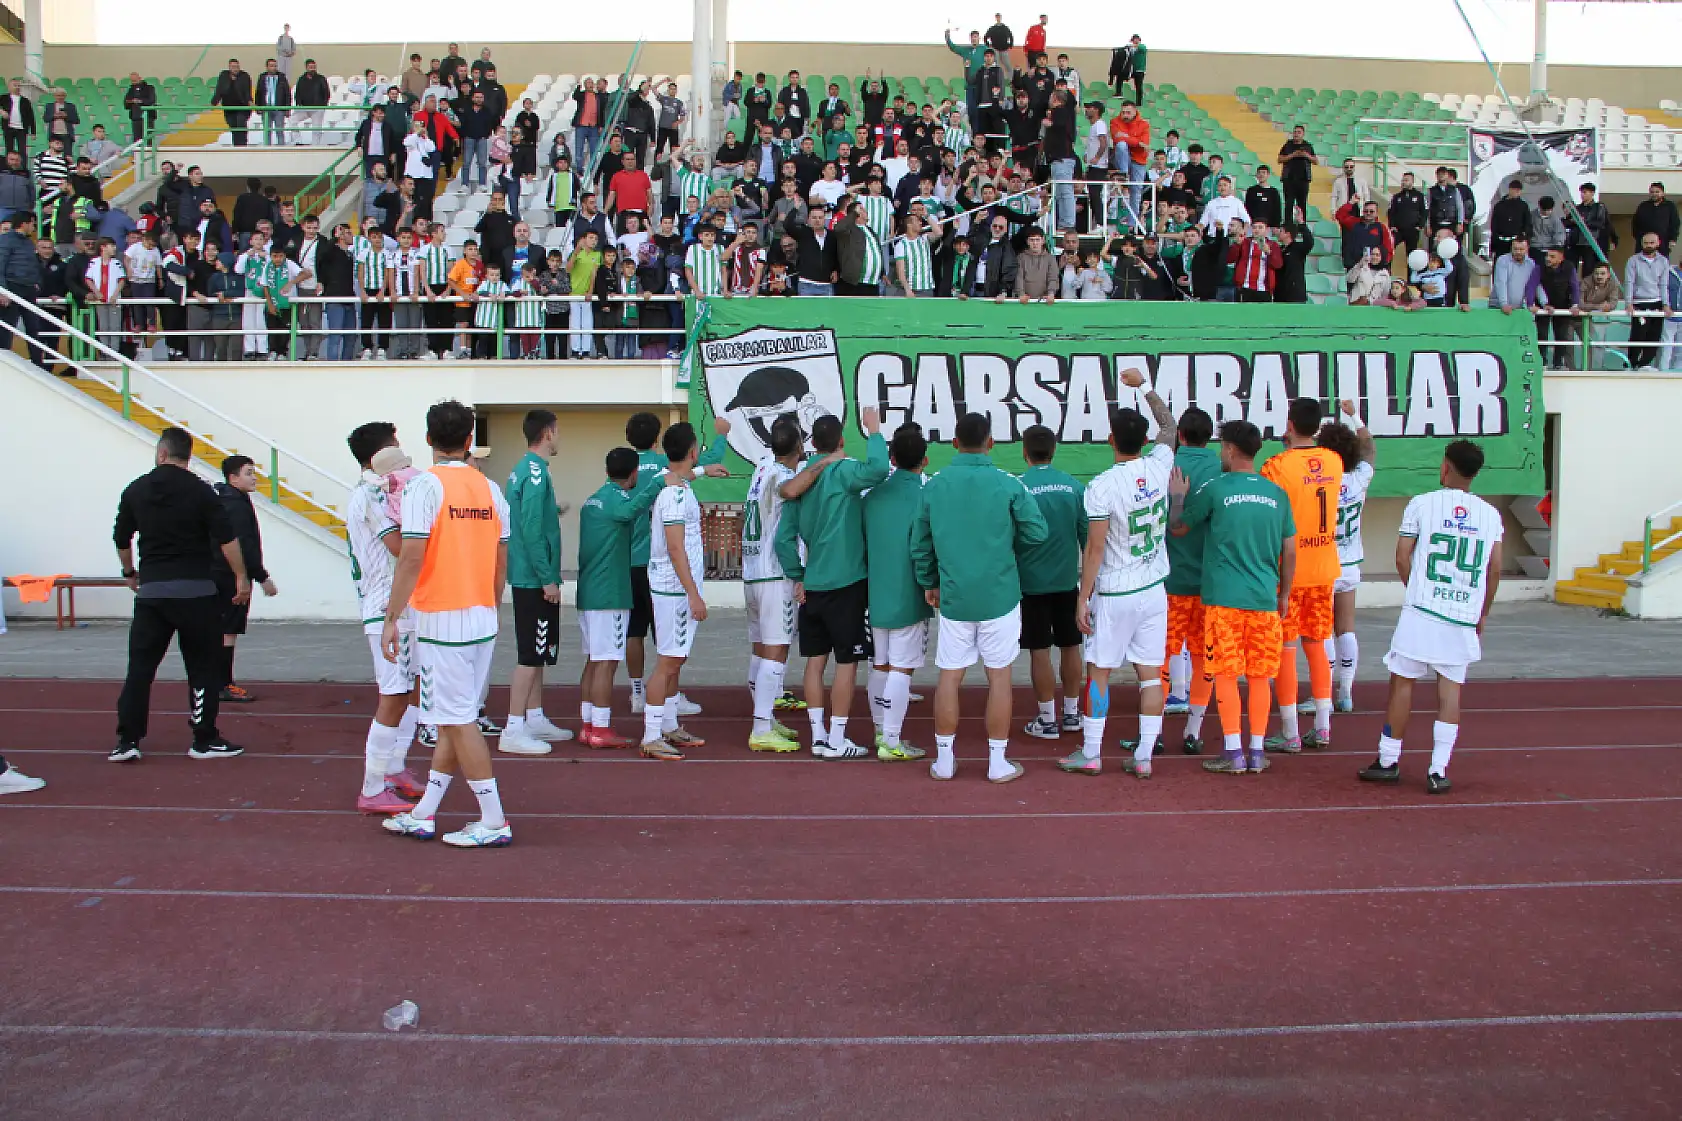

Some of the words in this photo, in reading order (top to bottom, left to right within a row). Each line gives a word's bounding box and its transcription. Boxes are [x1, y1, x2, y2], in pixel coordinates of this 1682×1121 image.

[448, 504, 493, 521] hummel
[1316, 487, 1327, 533] 1
[1427, 532, 1484, 588] 24
[1433, 587, 1470, 603] PEKER
